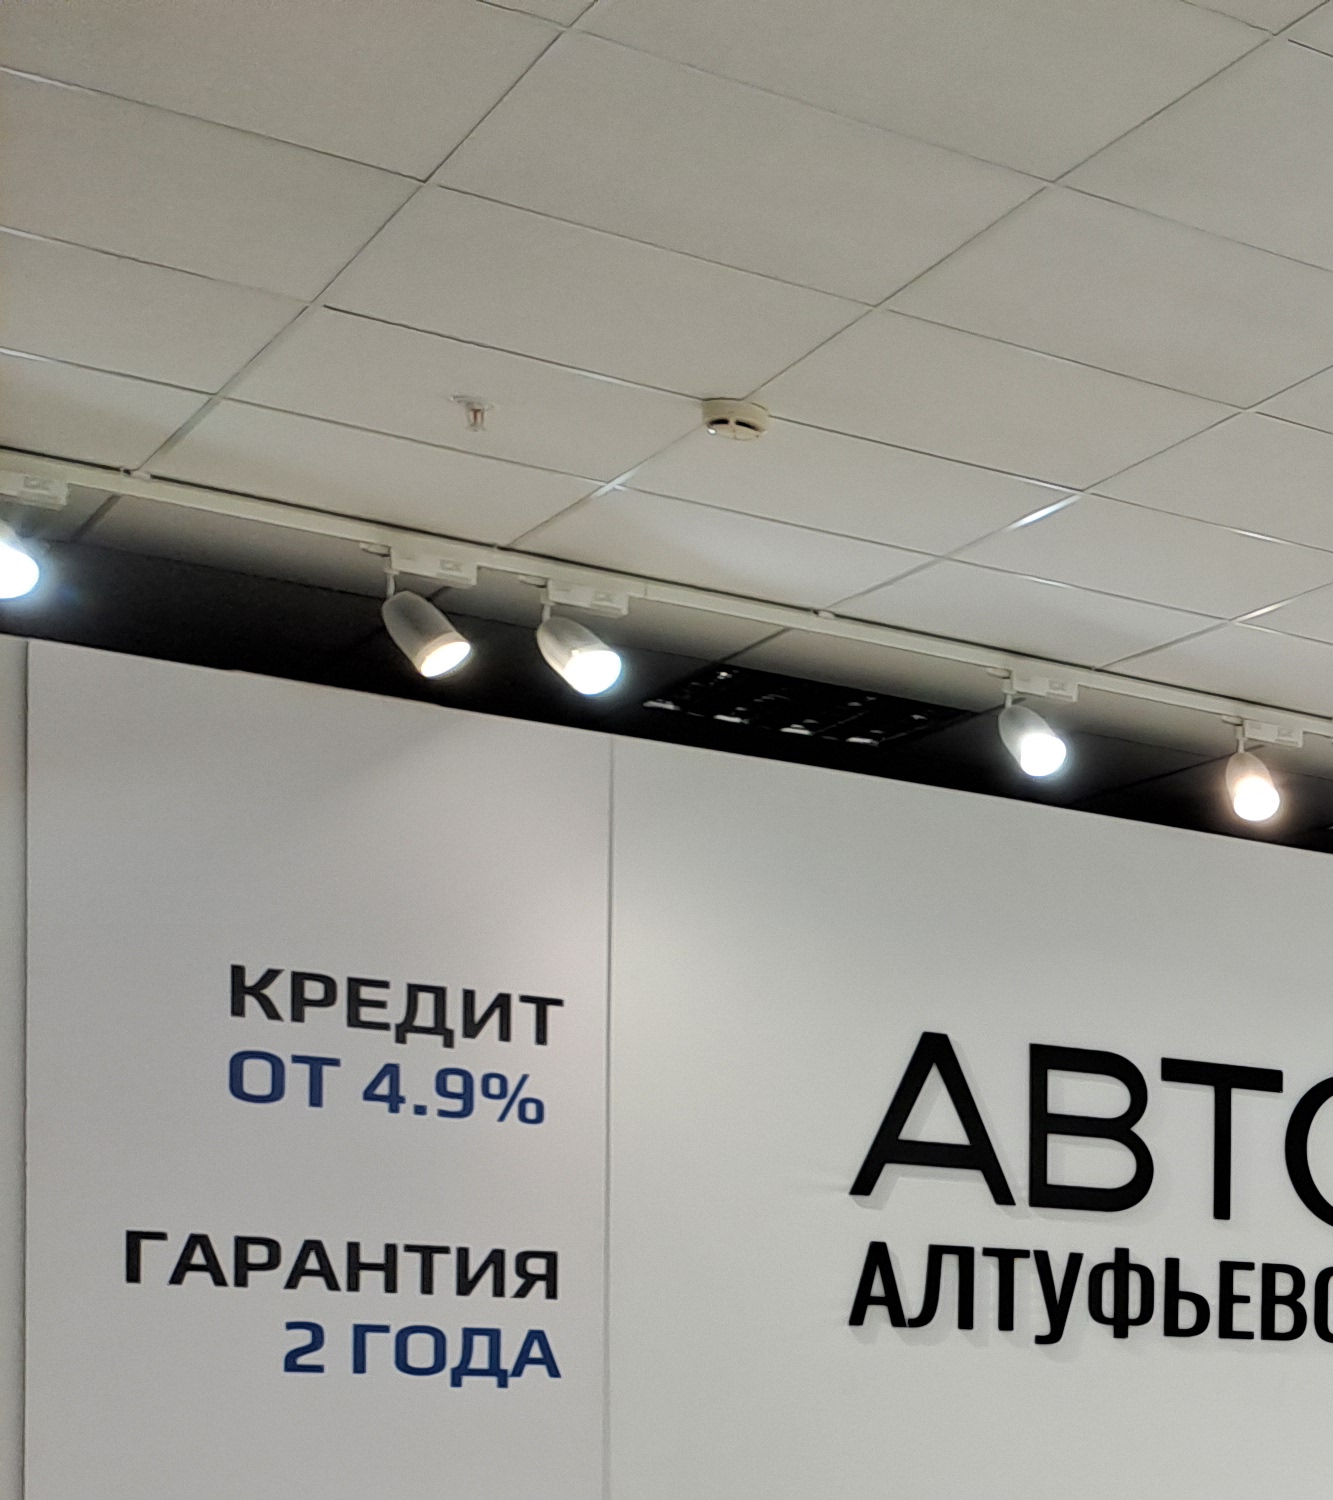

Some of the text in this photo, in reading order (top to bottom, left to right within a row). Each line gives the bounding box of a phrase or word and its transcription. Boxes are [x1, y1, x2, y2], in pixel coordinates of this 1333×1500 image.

[230, 963, 564, 1049] КРЕДИТ
[228, 1050, 546, 1125] ОТ 4.9%
[125, 1229, 559, 1301] ГАРАНТИЯ
[283, 1321, 562, 1389] 2 ГОДА
